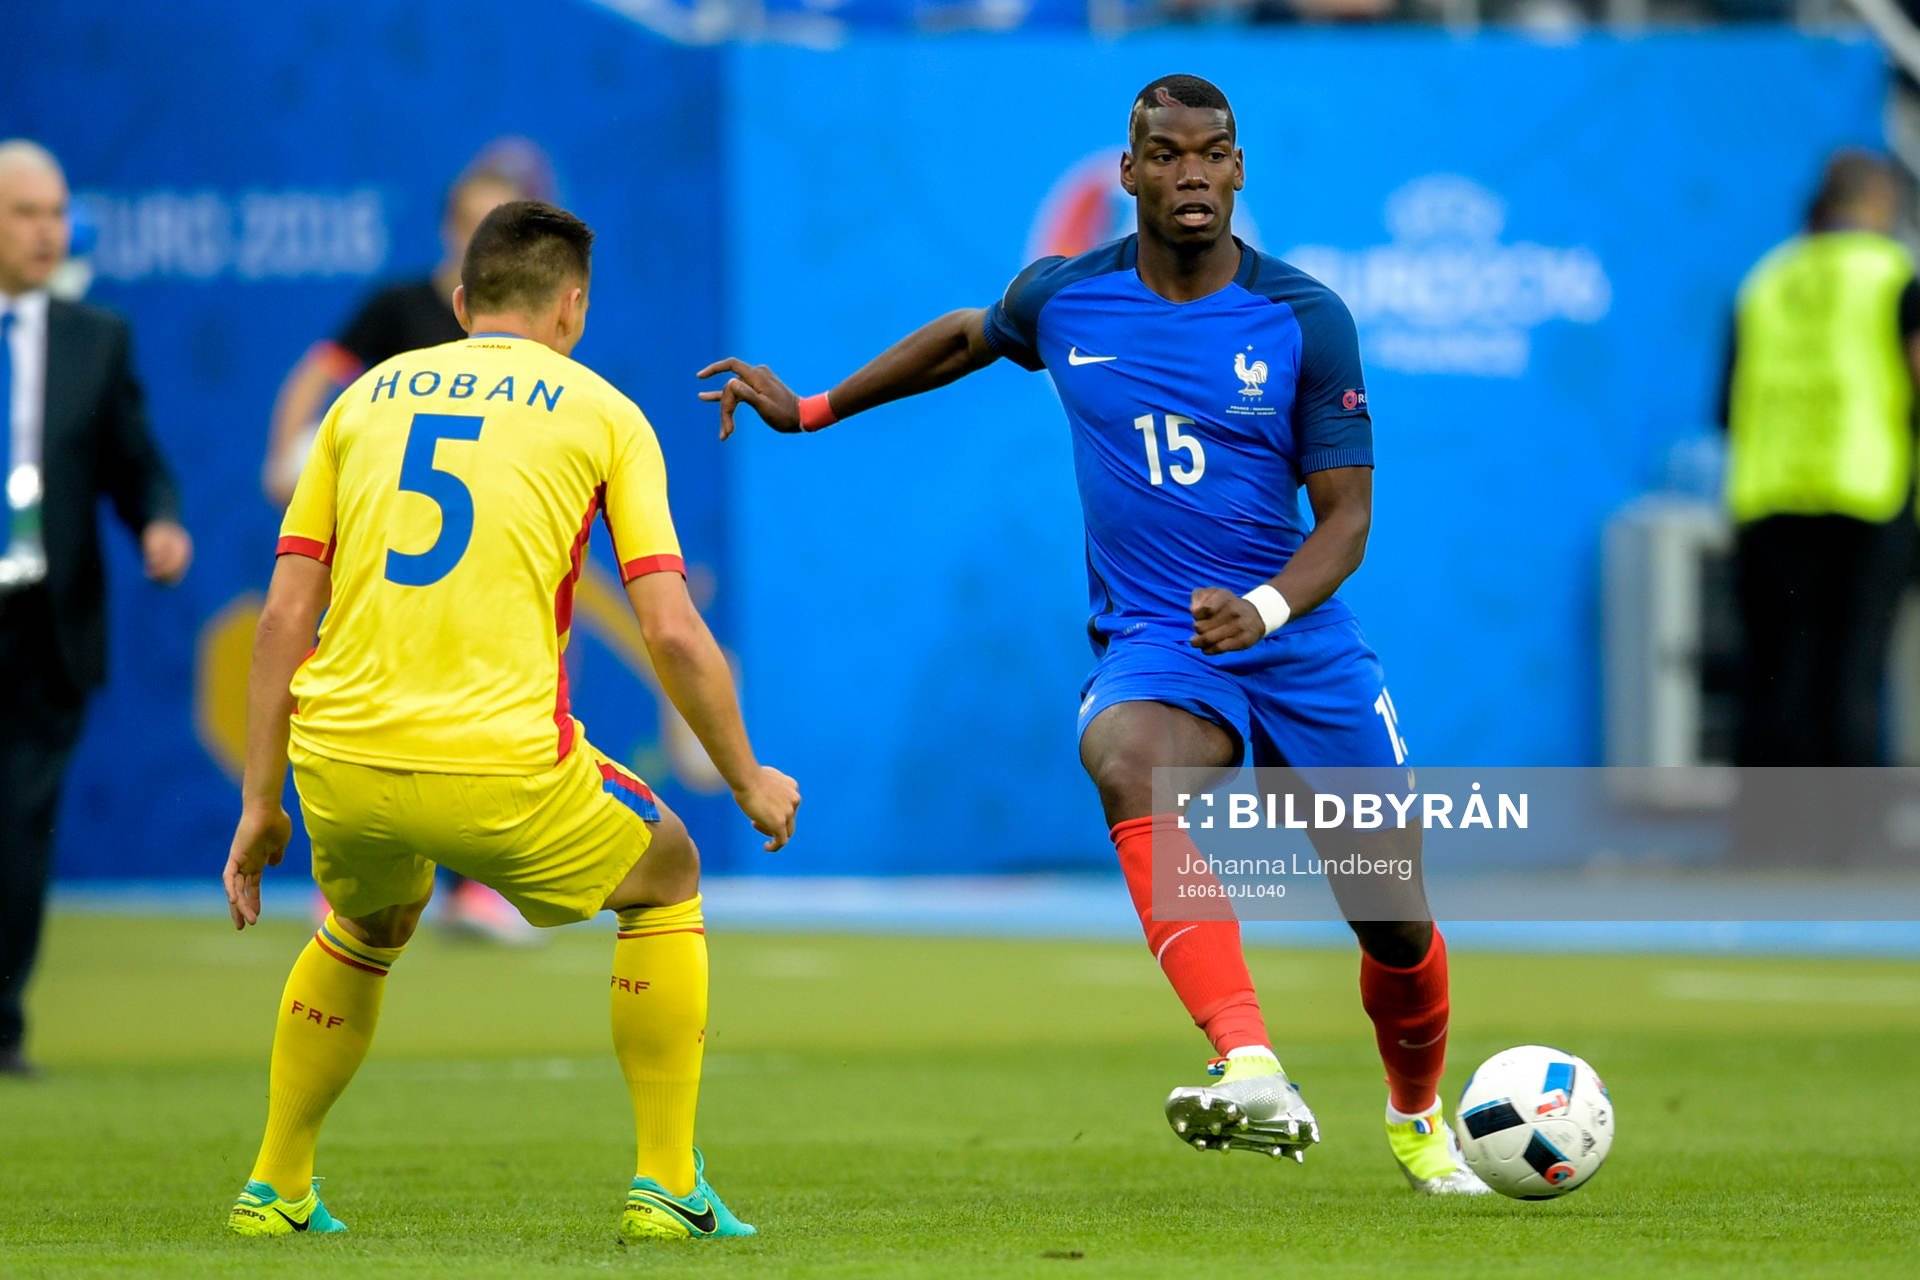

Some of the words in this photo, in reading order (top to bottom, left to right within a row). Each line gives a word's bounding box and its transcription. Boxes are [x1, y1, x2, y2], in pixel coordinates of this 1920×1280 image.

[371, 370, 565, 413] HOBAN
[1134, 413, 1206, 486] 15
[383, 412, 486, 587] 5
[610, 975, 650, 994] FRF
[291, 1000, 345, 1028] FRF
